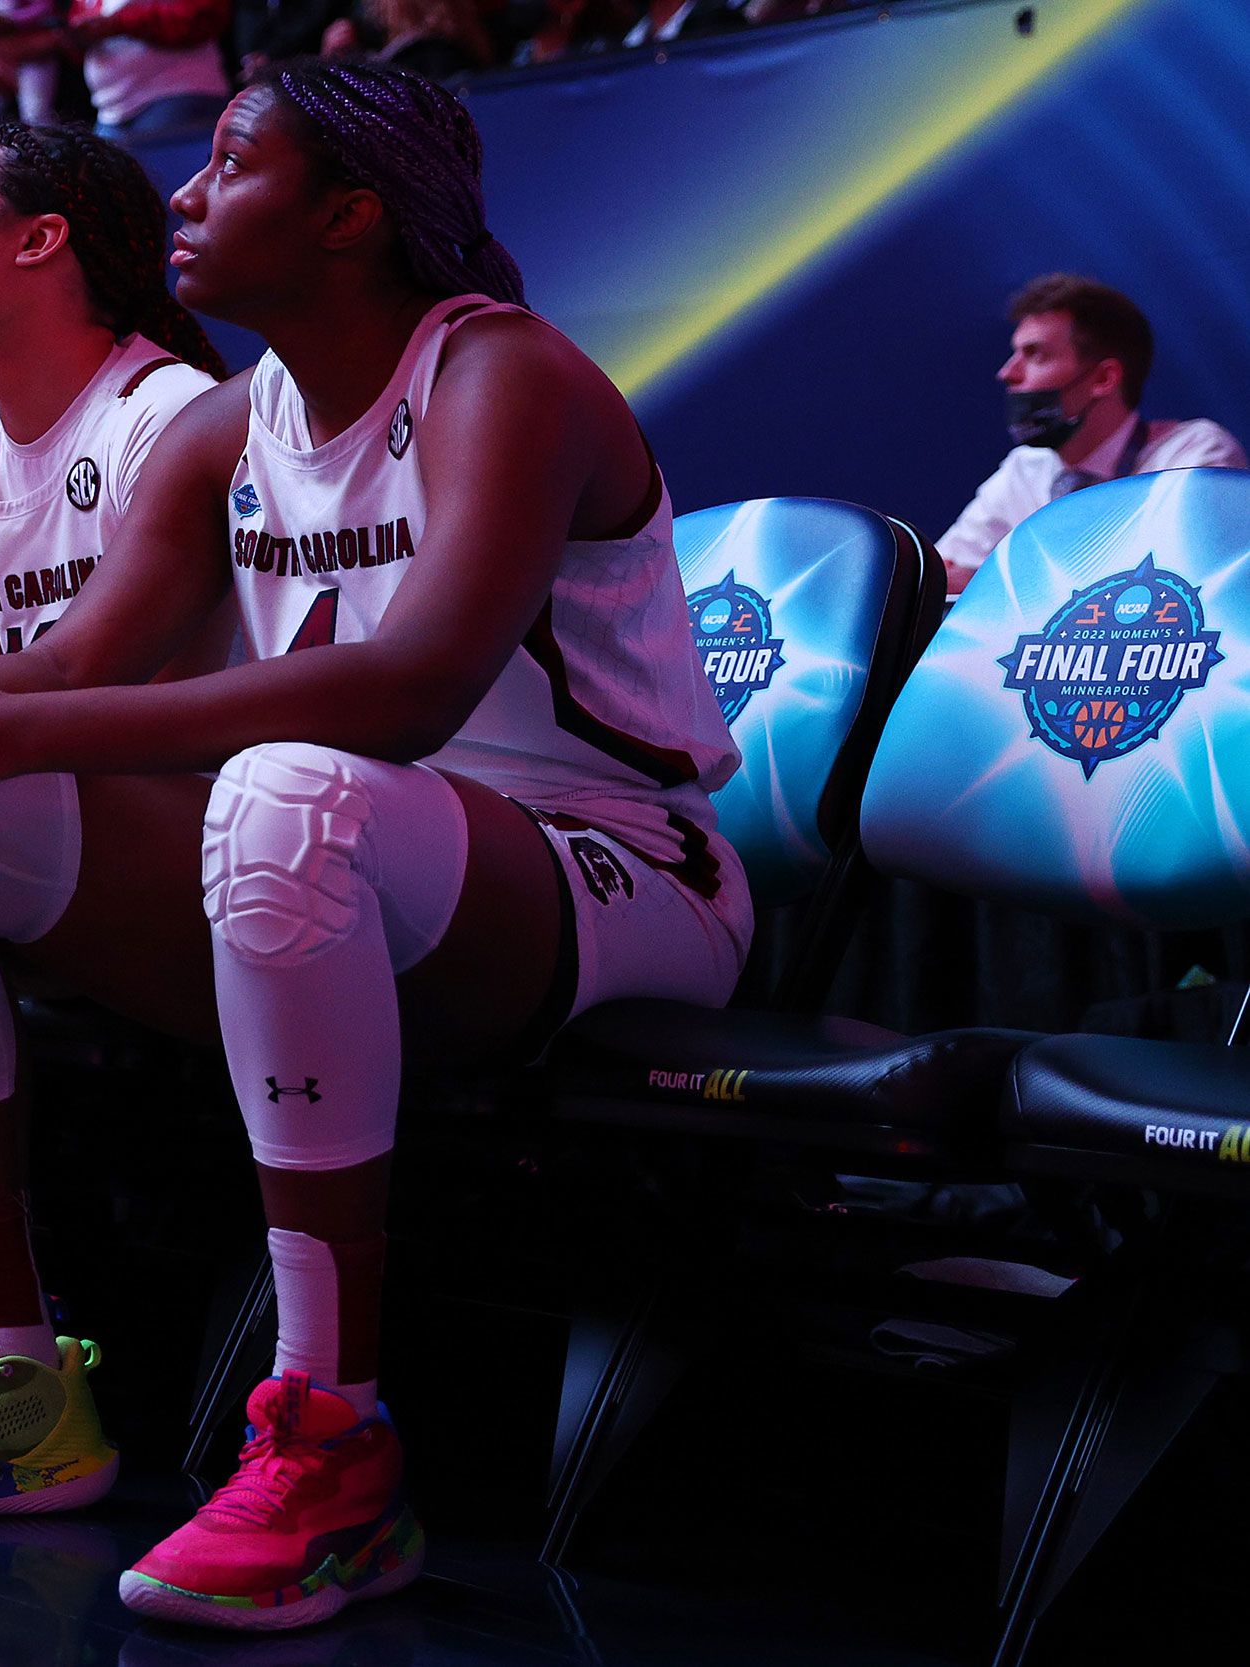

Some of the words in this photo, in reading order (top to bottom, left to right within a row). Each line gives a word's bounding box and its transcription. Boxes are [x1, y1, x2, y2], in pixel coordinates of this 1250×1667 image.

[69, 461, 96, 506] SEC
[300, 517, 415, 574] CAROLINA
[4, 554, 102, 610] CAROLIN
[1117, 604, 1149, 615] NCAA
[696, 637, 746, 648] WOMEN'S
[1073, 630, 1106, 639] 2022
[1111, 629, 1172, 639] WOMEN'S
[704, 649, 772, 684] FOUR
[1015, 644, 1109, 681] FINAL
[1117, 642, 1206, 681] FOUR
[1061, 685, 1150, 696] MINNEAPOLIS
[649, 1070, 688, 1089] FOUR
[690, 1074, 705, 1090] IT
[704, 1069, 748, 1100] ALL
[1145, 1125, 1196, 1149] FOUR
[1199, 1131, 1219, 1150] IT
